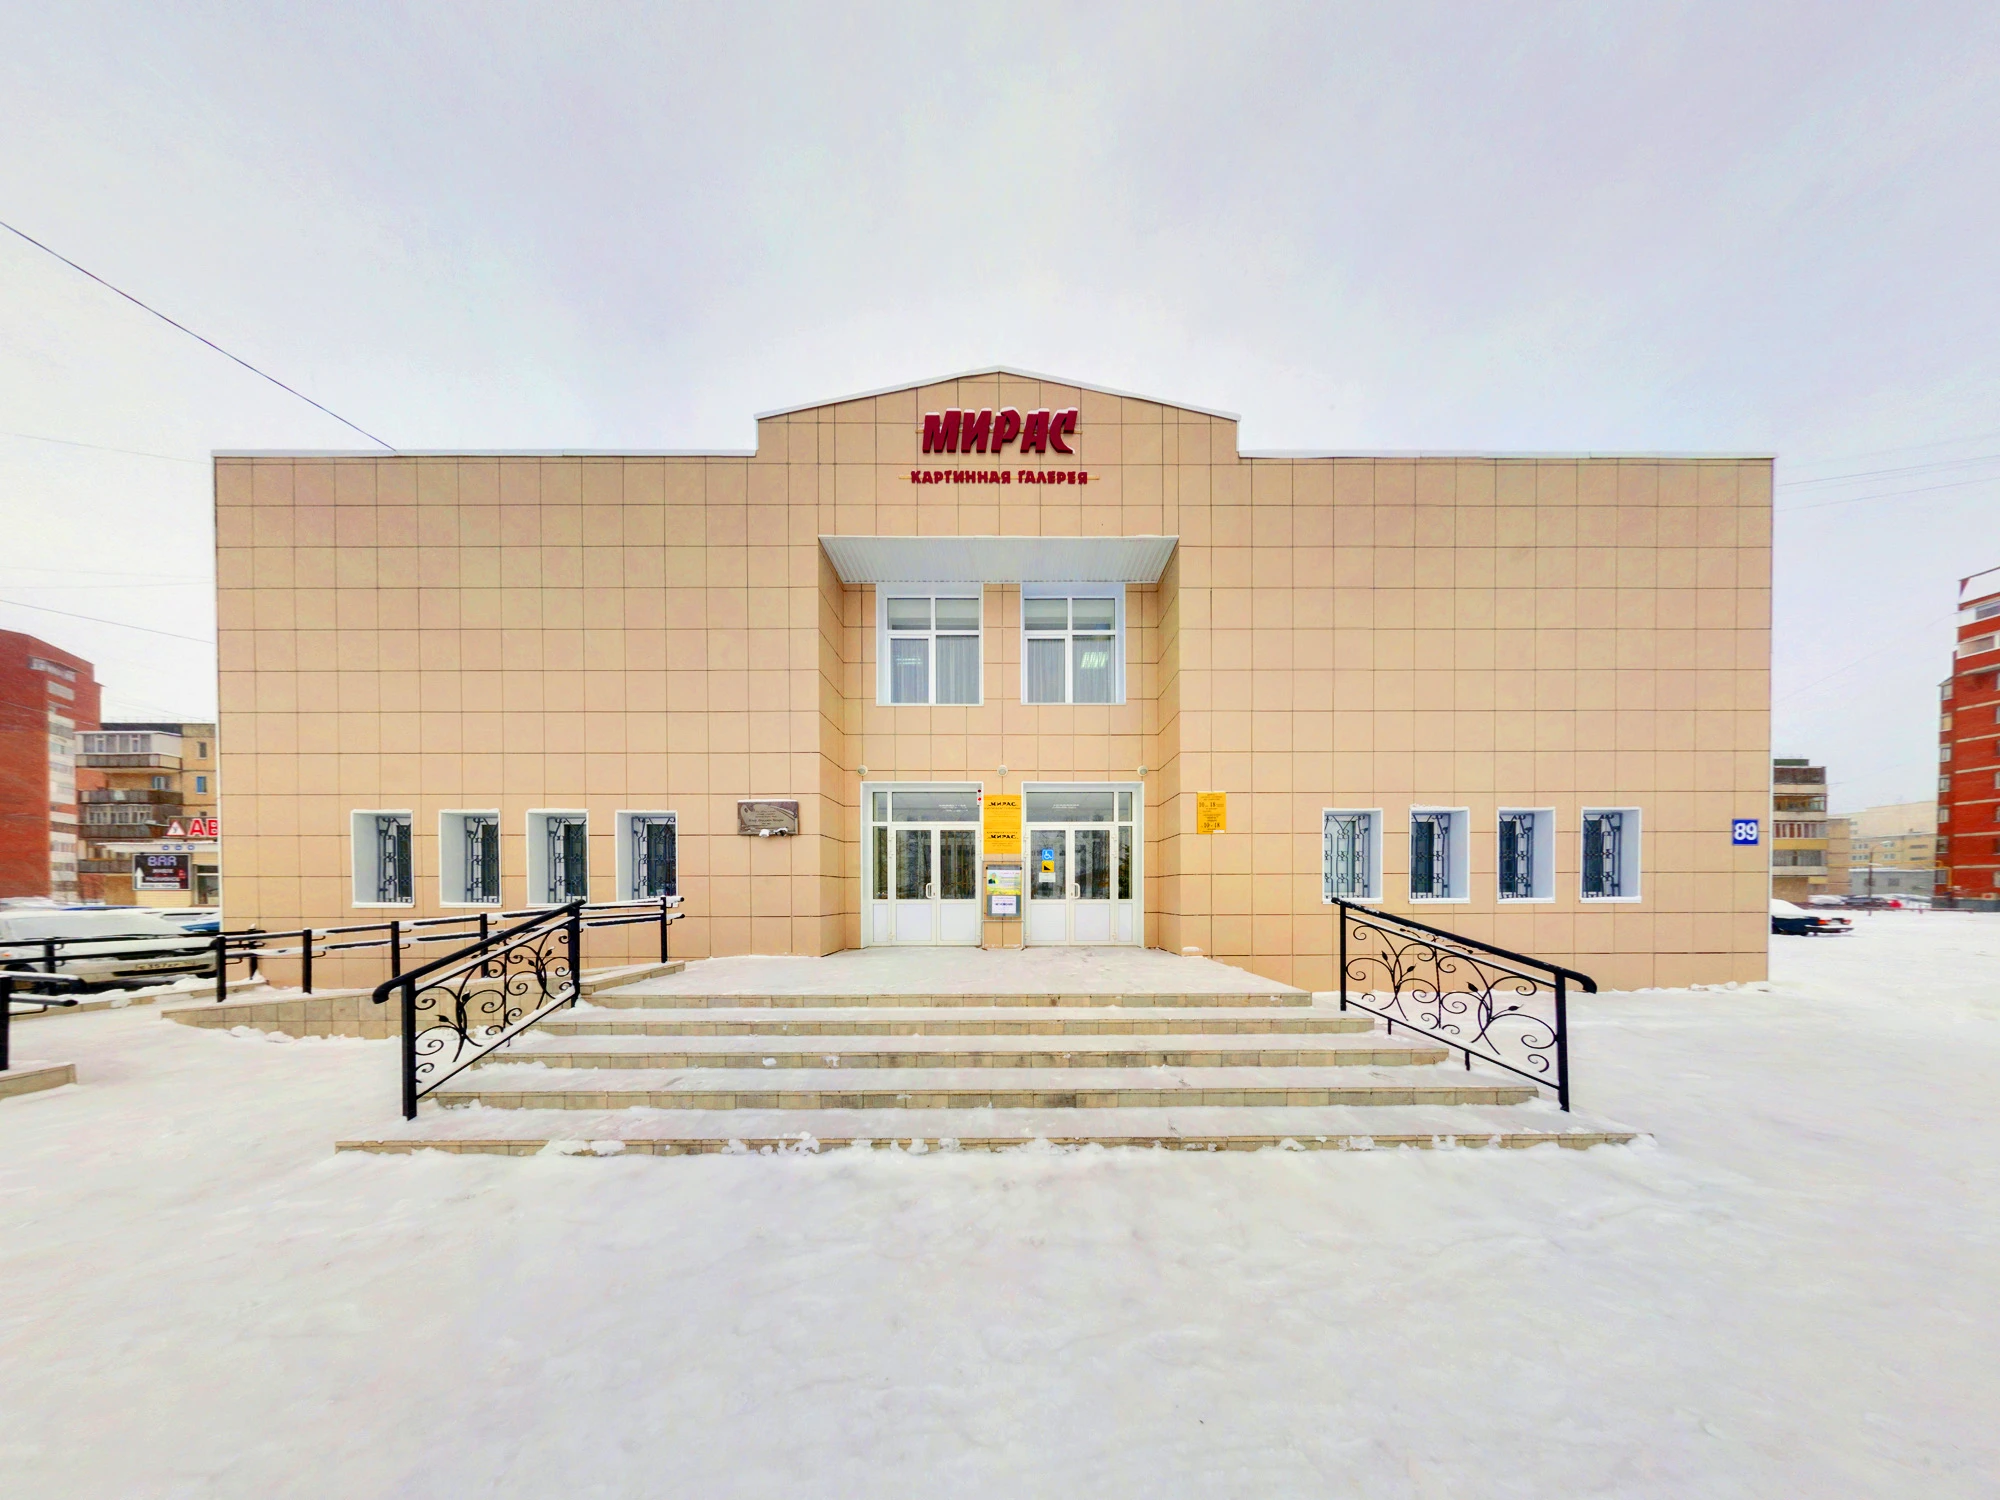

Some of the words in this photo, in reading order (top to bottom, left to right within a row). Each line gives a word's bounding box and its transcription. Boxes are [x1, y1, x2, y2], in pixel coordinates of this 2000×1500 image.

[922, 407, 1078, 454] МИРАС
[910, 470, 1011, 485] КАРТИННАЯ
[1018, 470, 1088, 485] ГАЛЕРЕЯ
[1734, 822, 1757, 841] 89
[147, 855, 178, 867] BAR
